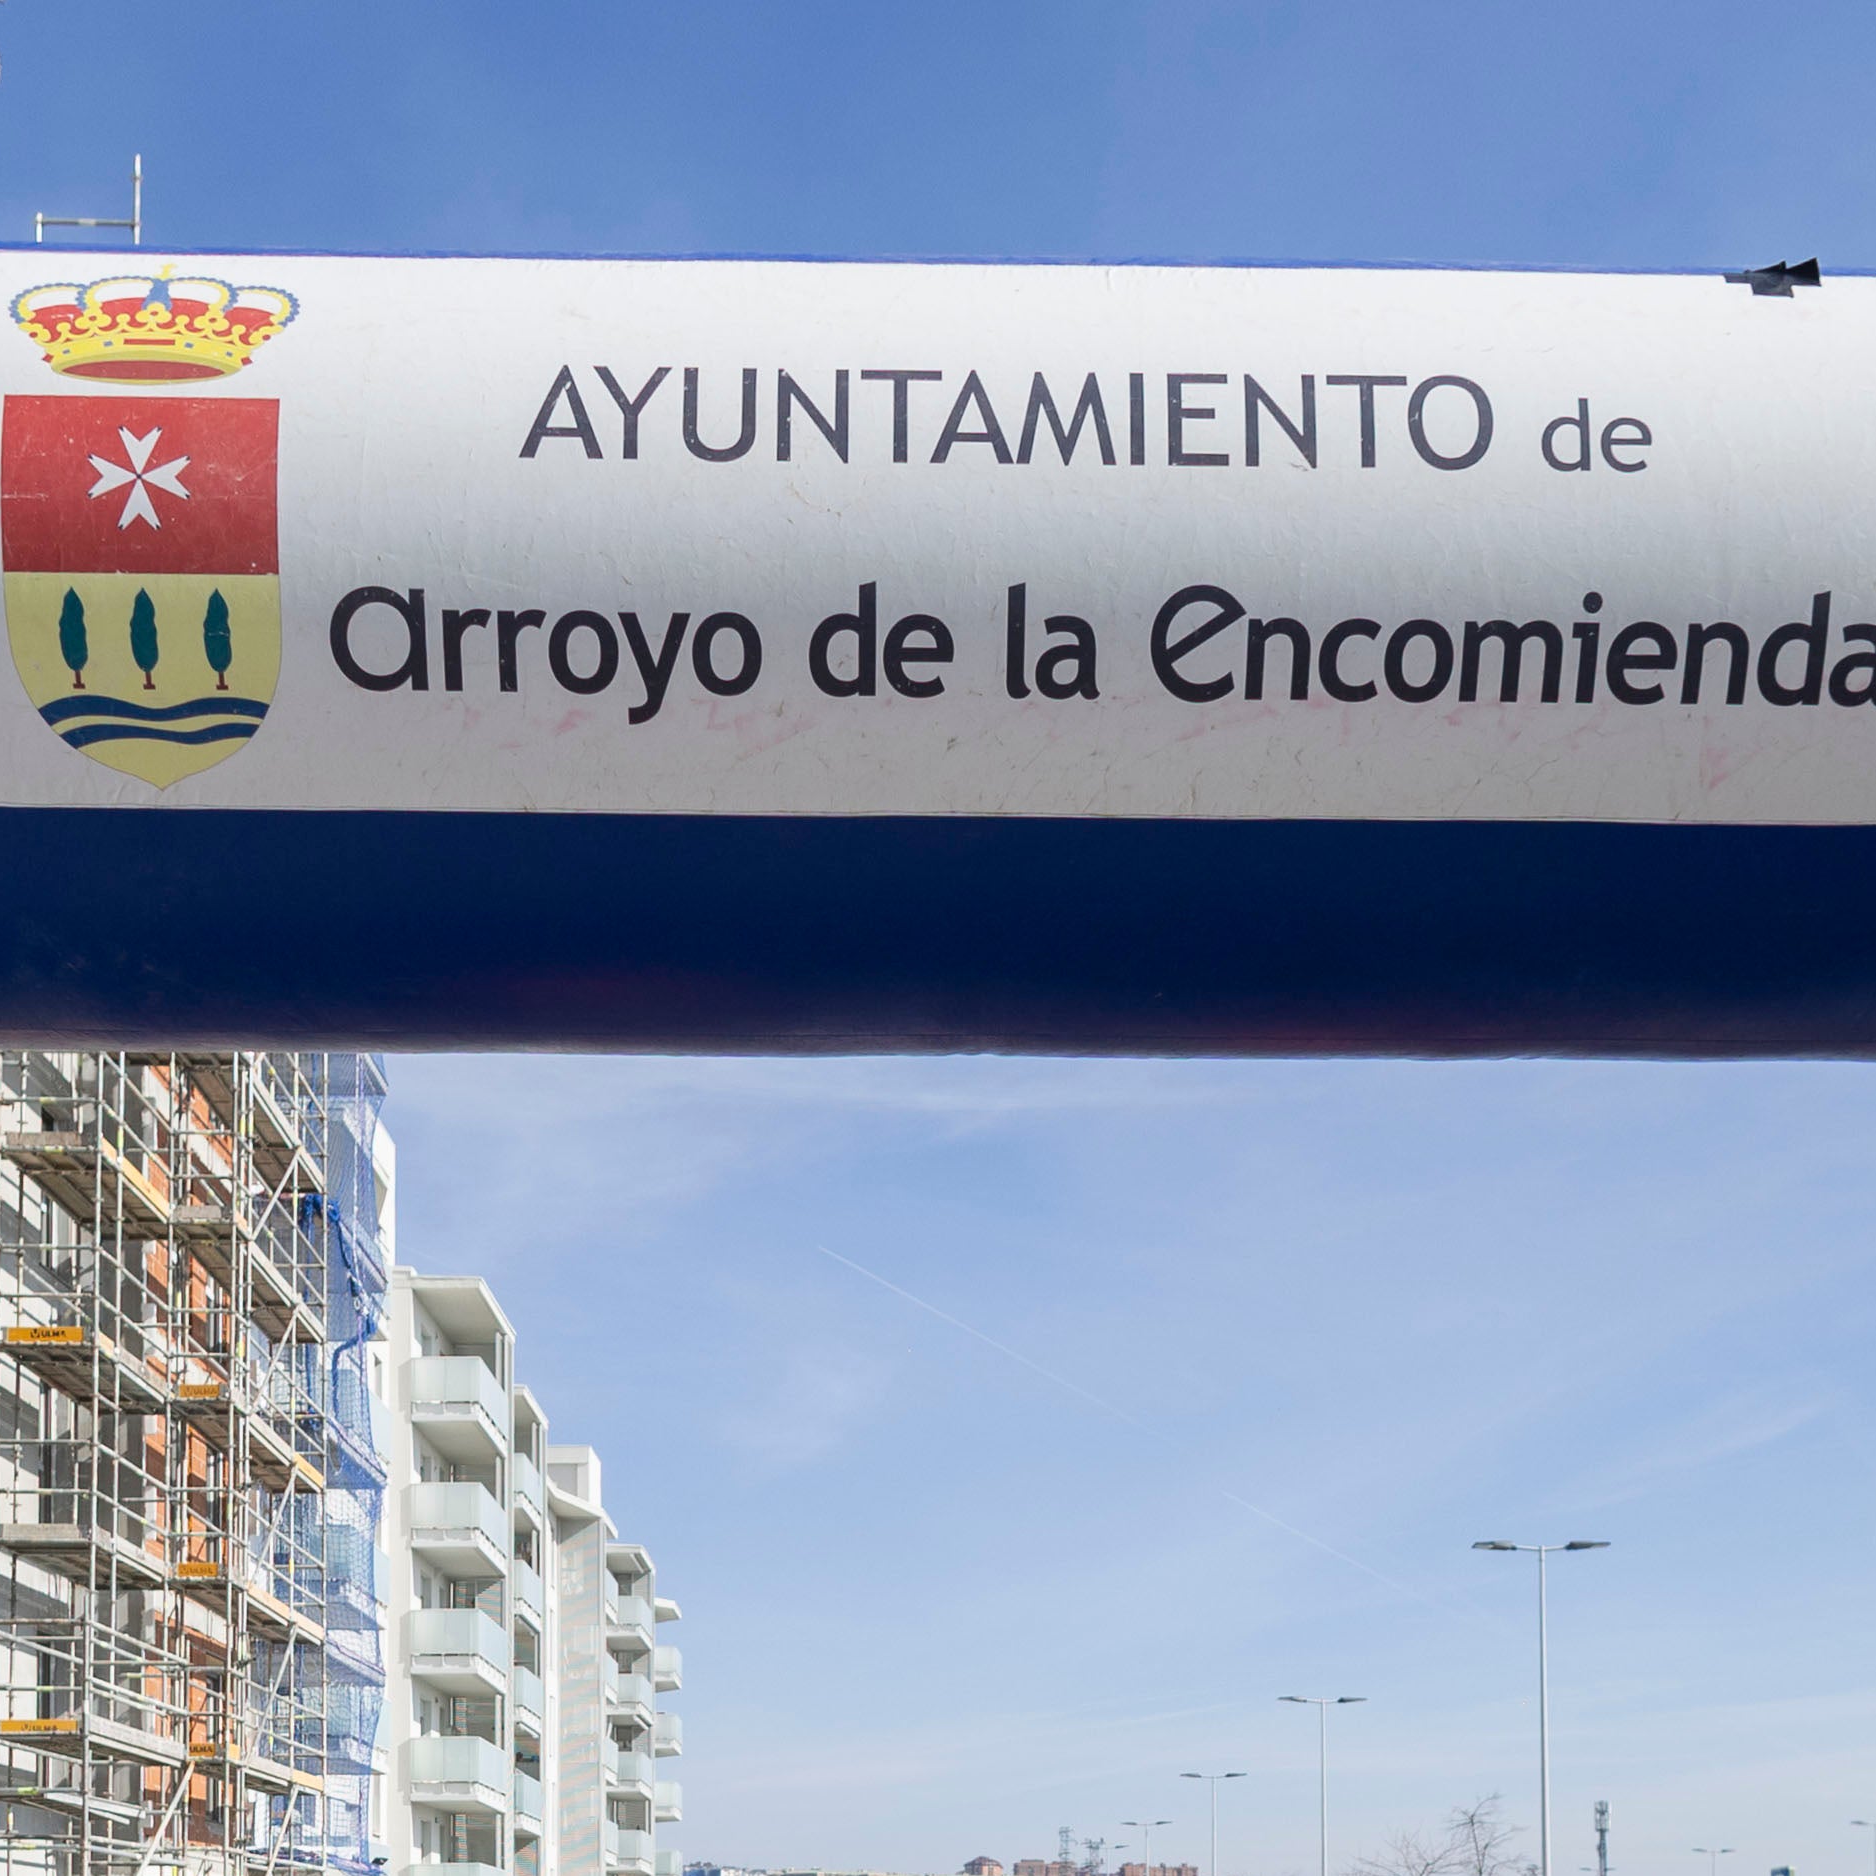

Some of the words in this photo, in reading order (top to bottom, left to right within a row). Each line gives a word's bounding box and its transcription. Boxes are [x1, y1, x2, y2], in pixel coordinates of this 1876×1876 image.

[519, 363, 1494, 471] AYUNTAMIENTO
[1541, 398, 1653, 473] de
[808, 581, 954, 700] de
[1007, 582, 1099, 700] la
